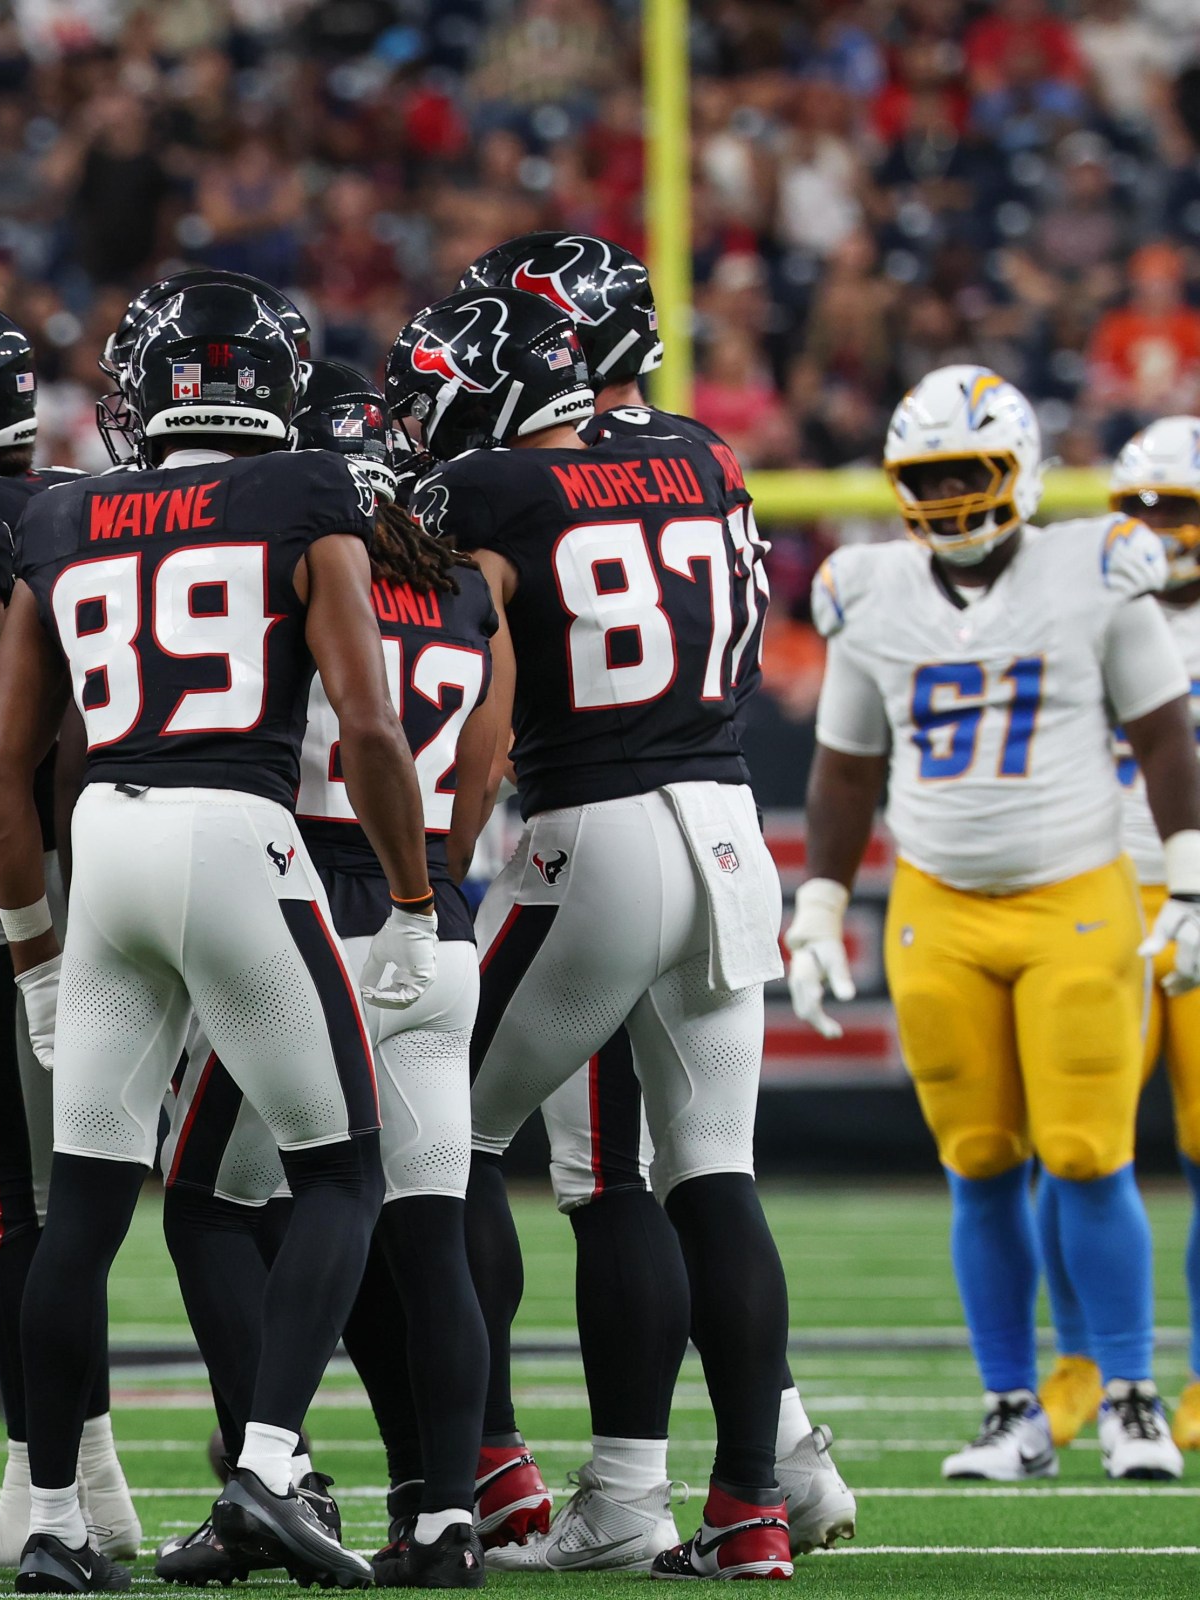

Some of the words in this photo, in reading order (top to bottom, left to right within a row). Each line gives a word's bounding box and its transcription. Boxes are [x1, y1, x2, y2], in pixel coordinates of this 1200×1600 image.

[164, 415, 269, 430] HOUSTON
[89, 479, 222, 541] WAYNE
[550, 457, 705, 511] MOREAU
[550, 515, 736, 713] 87
[50, 541, 289, 754] 89
[911, 654, 1046, 785] 61
[717, 853, 738, 871] NFL
